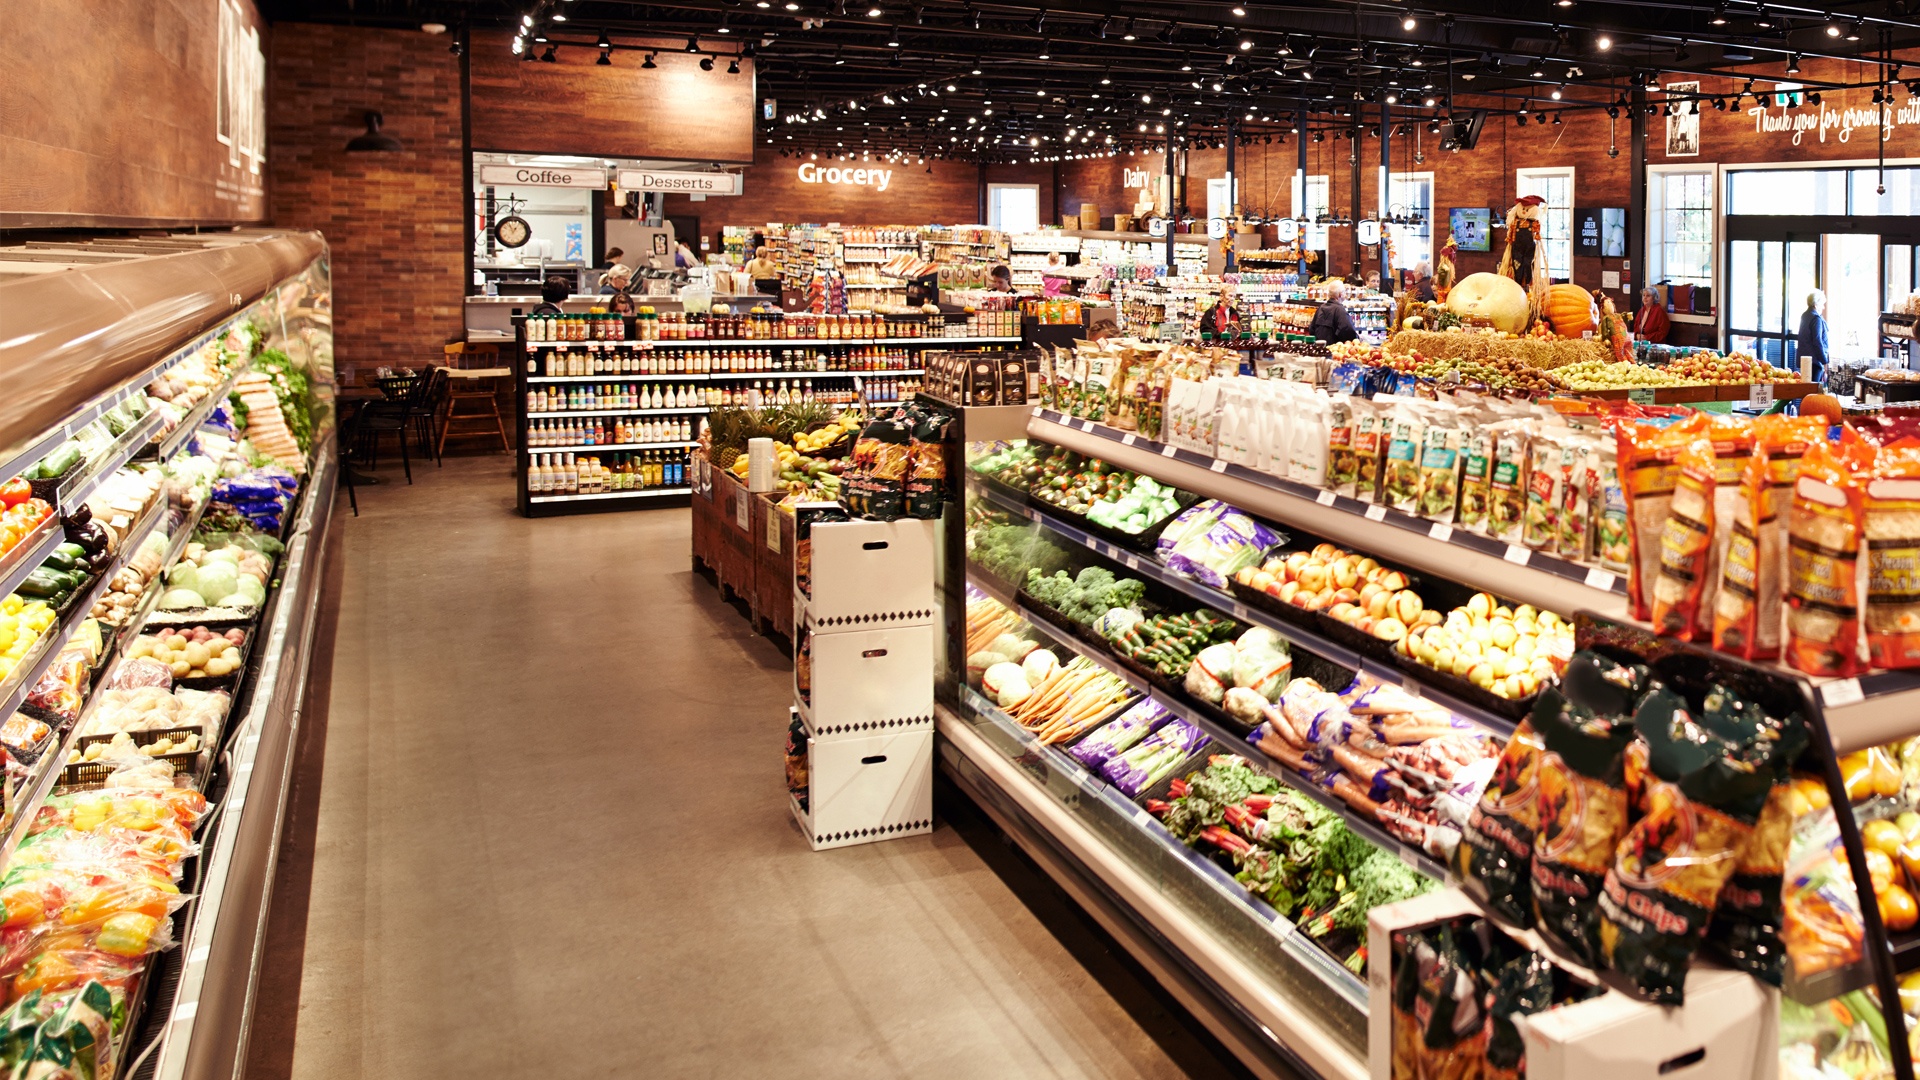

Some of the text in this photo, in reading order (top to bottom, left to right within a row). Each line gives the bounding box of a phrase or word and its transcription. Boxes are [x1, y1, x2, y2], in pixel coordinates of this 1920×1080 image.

[1748, 104, 1792, 133] Thank
[1792, 113, 1818, 146] you
[1819, 101, 1841, 143] for
[516, 169, 572, 184] Coffee
[642, 174, 713, 190] Desserts
[797, 162, 892, 192] Grocery
[1123, 166, 1150, 190] Dairy
[1154, 220, 1160, 230] 4
[1214, 221, 1221, 231] 3
[1285, 222, 1291, 233] 2
[1481, 816, 1530, 859] Chips
[1627, 890, 1689, 936] Chips
